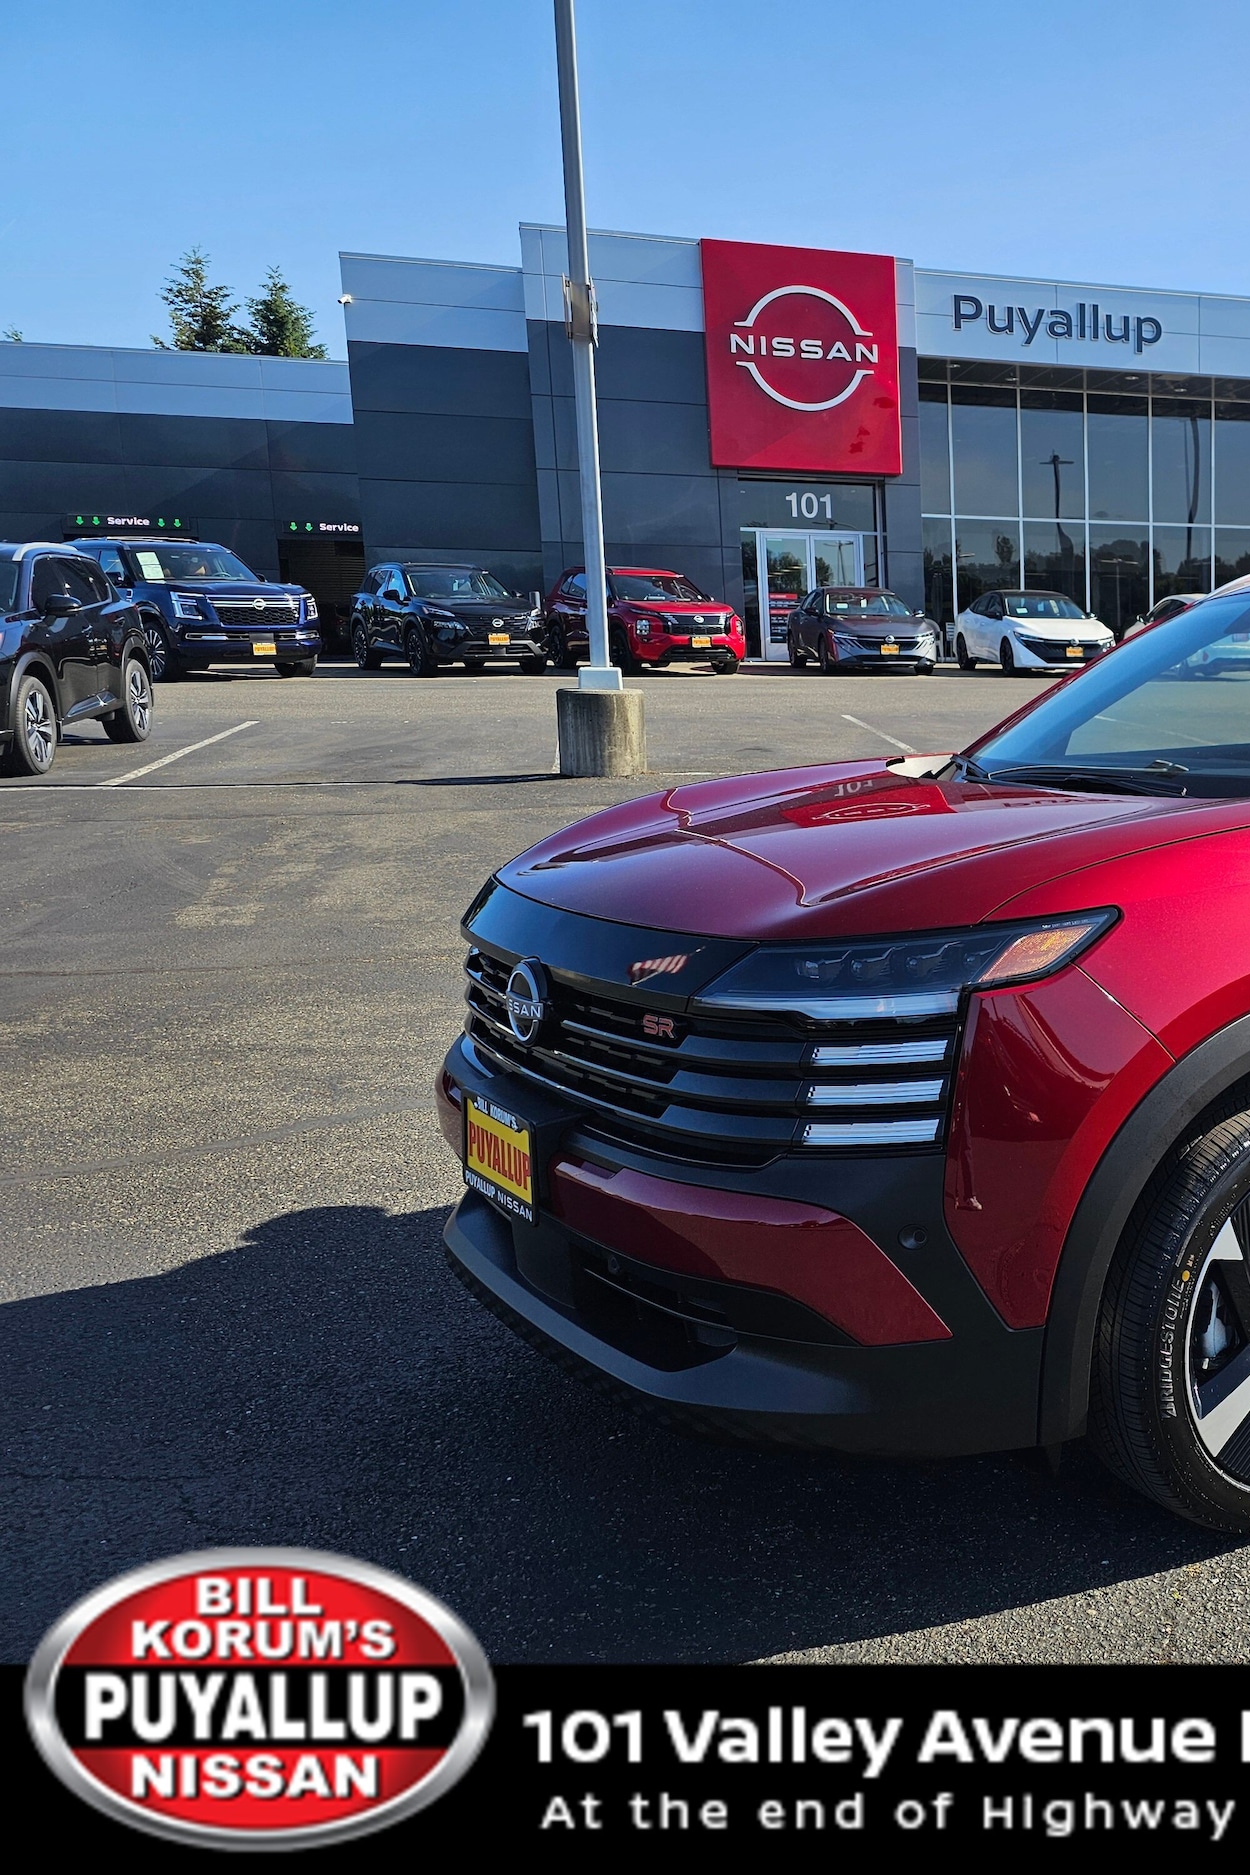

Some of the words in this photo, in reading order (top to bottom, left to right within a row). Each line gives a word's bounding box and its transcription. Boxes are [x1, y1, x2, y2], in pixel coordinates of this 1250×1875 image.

[951, 293, 1163, 355] Puyallup
[729, 333, 879, 364] NISSAN
[785, 492, 832, 519] 101
[106, 515, 150, 526] Service
[318, 522, 360, 533] Service
[642, 1014, 675, 1039] SR
[468, 1120, 531, 1191] PUYALLUP
[465, 1169, 496, 1199] PUYALLUP
[497, 1190, 533, 1222] NISSAN
